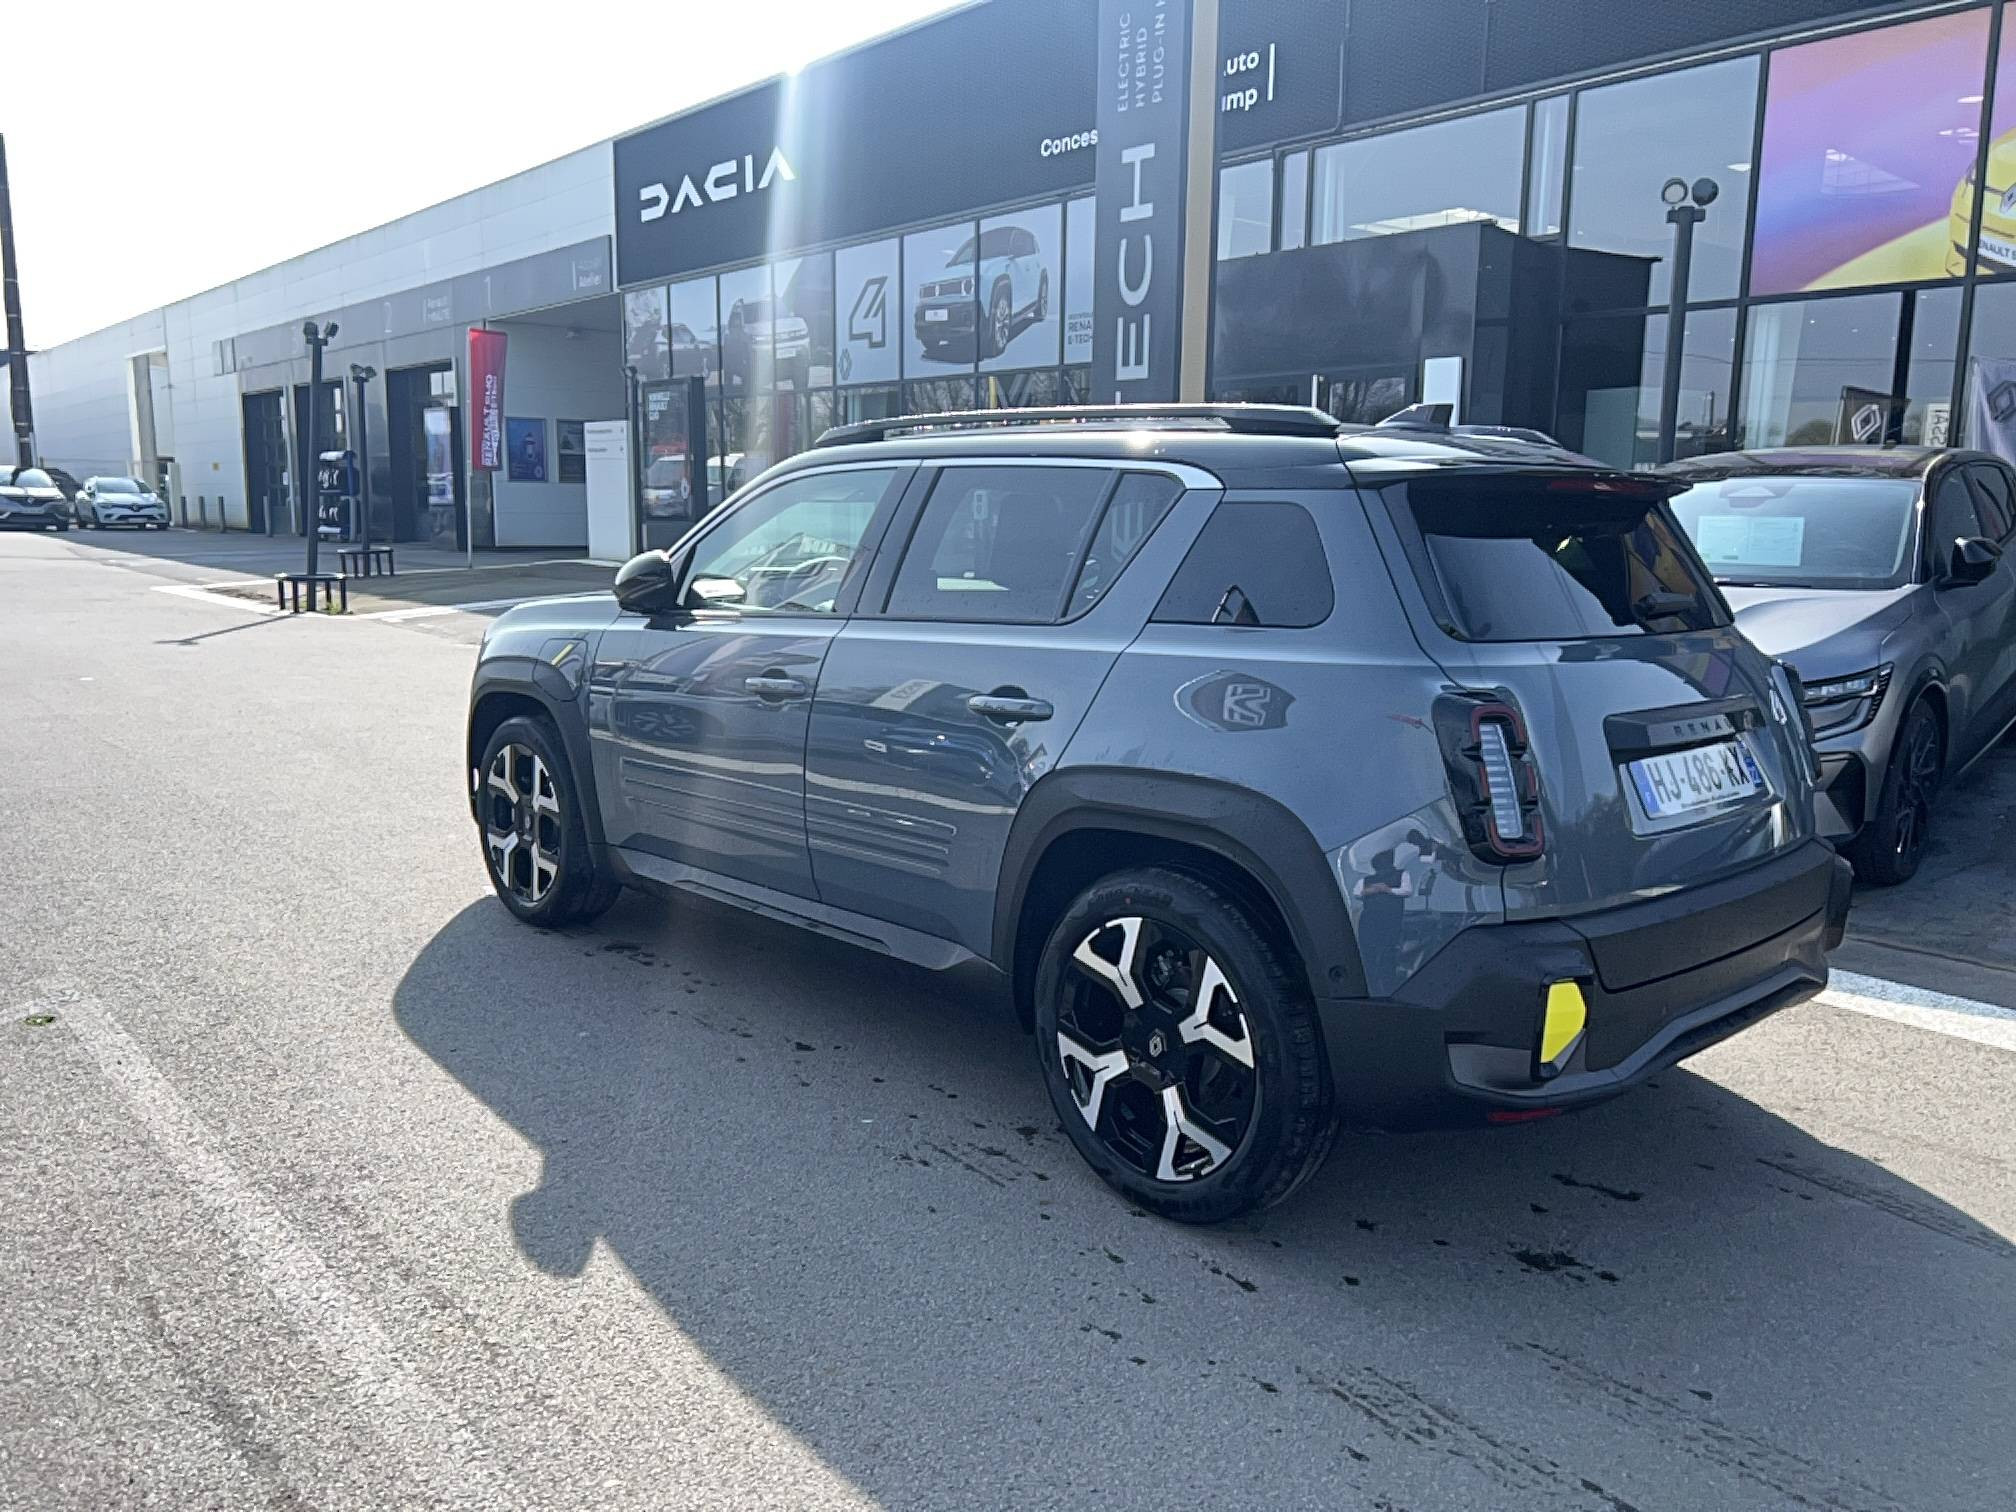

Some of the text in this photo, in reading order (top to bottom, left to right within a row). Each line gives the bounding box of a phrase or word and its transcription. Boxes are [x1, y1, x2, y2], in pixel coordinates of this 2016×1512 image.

[1117, 13, 1130, 112] ELECTRIC
[1135, 27, 1147, 107] HYBRID
[1152, 13, 1165, 103] PLUG-IN
[1223, 52, 1260, 77] uto
[1222, 88, 1258, 111] mp
[1040, 129, 1098, 157] Conces
[640, 145, 796, 223] DACIA
[848, 276, 888, 348] 4
